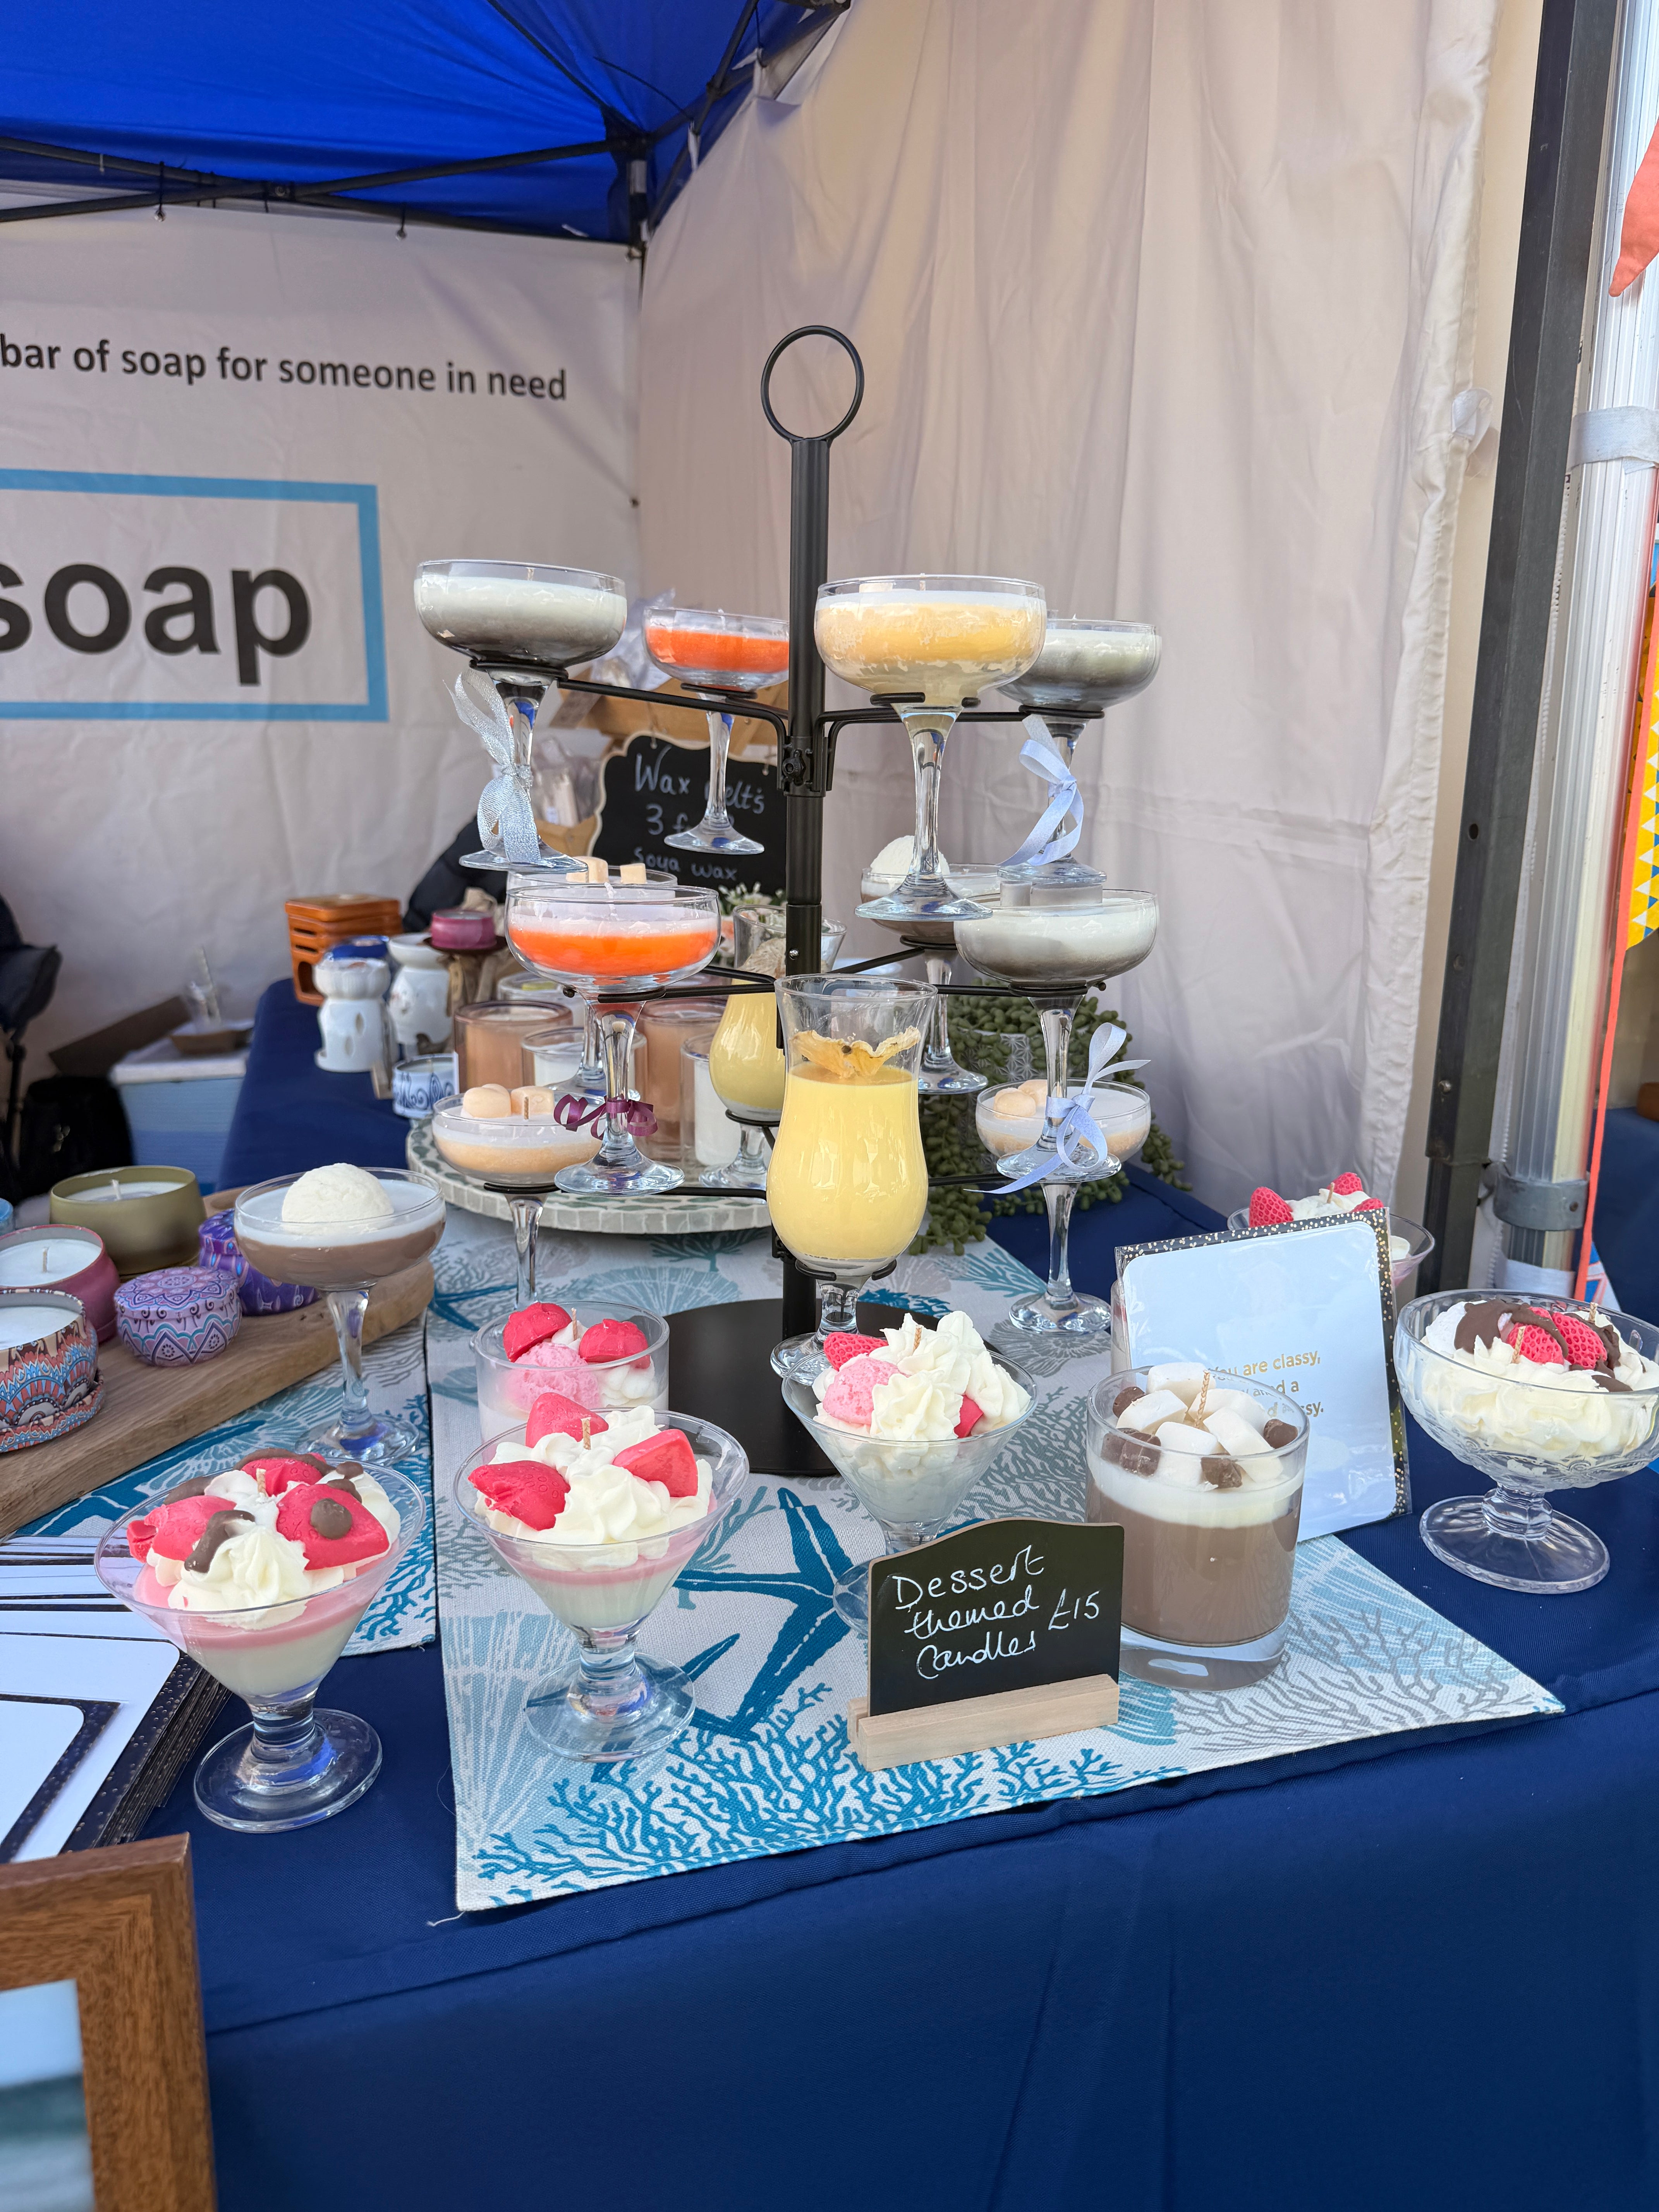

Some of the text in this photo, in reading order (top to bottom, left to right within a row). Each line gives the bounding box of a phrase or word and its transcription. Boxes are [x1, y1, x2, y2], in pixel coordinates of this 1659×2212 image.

[0, 333, 566, 400] bar of soap for someone in need
[635, 744, 691, 796] Wax
[646, 803, 664, 835] 3
[1243, 1361, 1267, 1376] are
[1273, 1350, 1321, 1370] classy,
[1290, 1381, 1299, 1393] a
[892, 1544, 1044, 1613] Dessert
[904, 1584, 1039, 1640] themed
[1048, 1588, 1100, 1630] £15
[916, 1630, 1036, 1679] Candles
